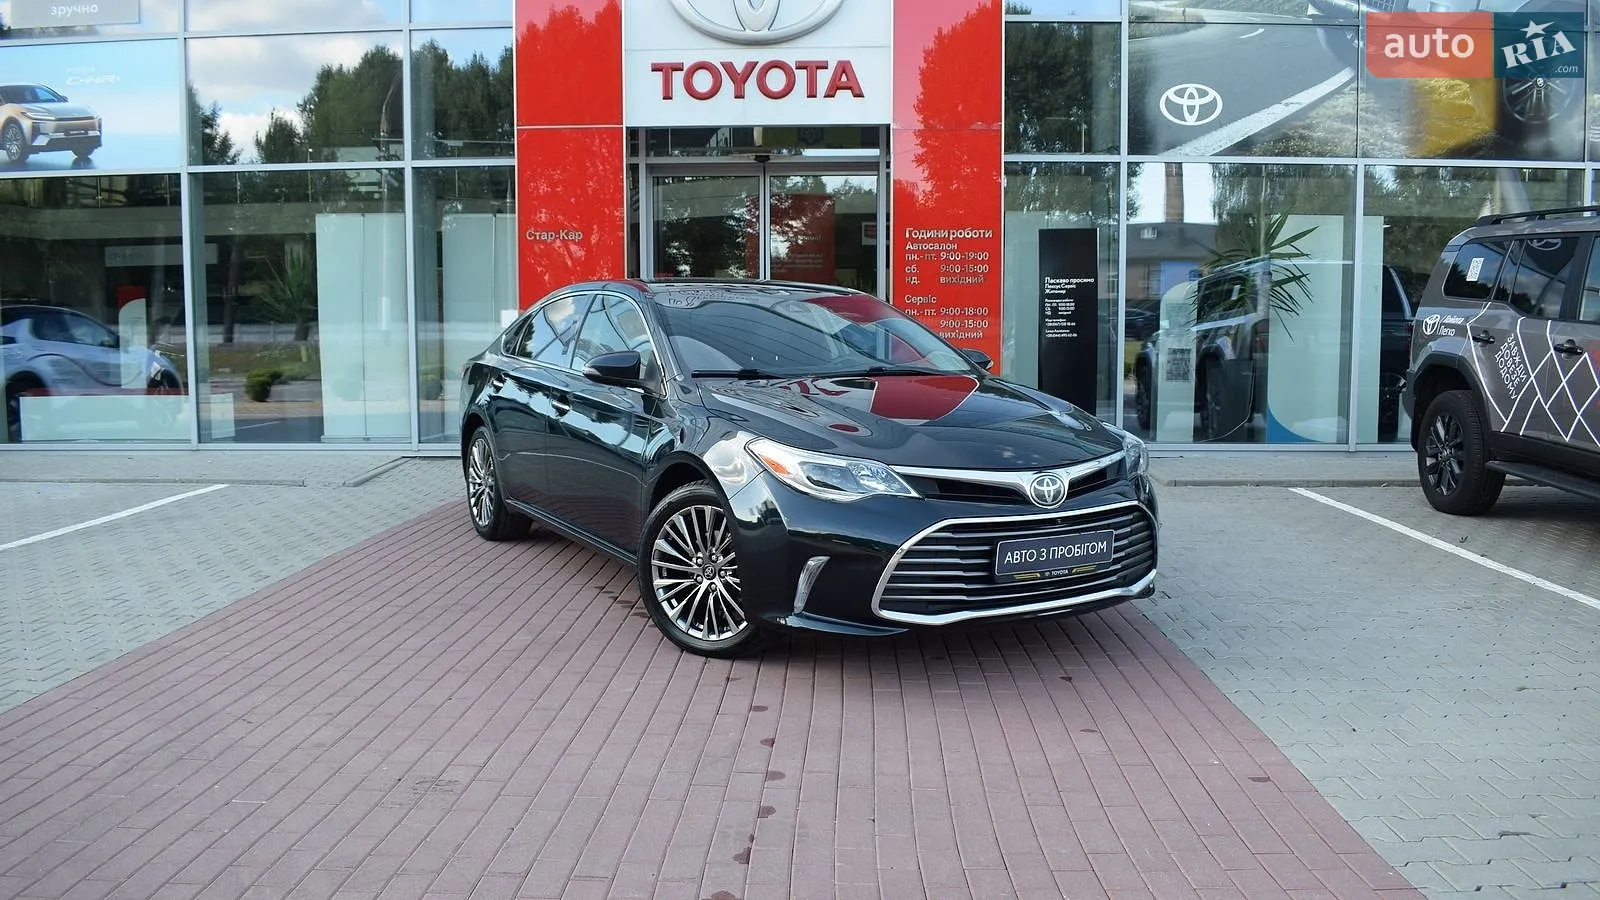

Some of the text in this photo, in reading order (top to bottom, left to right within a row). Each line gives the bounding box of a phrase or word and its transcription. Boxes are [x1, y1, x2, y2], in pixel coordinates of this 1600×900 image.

[51, 4, 99, 17] зручно
[651, 60, 865, 100] TOYOTA
[526, 229, 583, 242] Стар-Кар
[905, 227, 993, 241] Години роботи
[905, 242, 958, 250] Автосалон
[905, 264, 920, 273] сб.
[905, 275, 985, 285] нд. вихідний
[905, 294, 937, 305] Сервіс
[1507, 333, 1528, 382] ЗАВЖДИ
[1500, 342, 1520, 387] ДОВЕЗЕ
[1494, 351, 1518, 399] ДОДОМУ
[1004, 549, 1037, 565] АВТО
[1049, 540, 1107, 560] ПРОБІГОМ
[1051, 568, 1069, 576] TOYOTA
